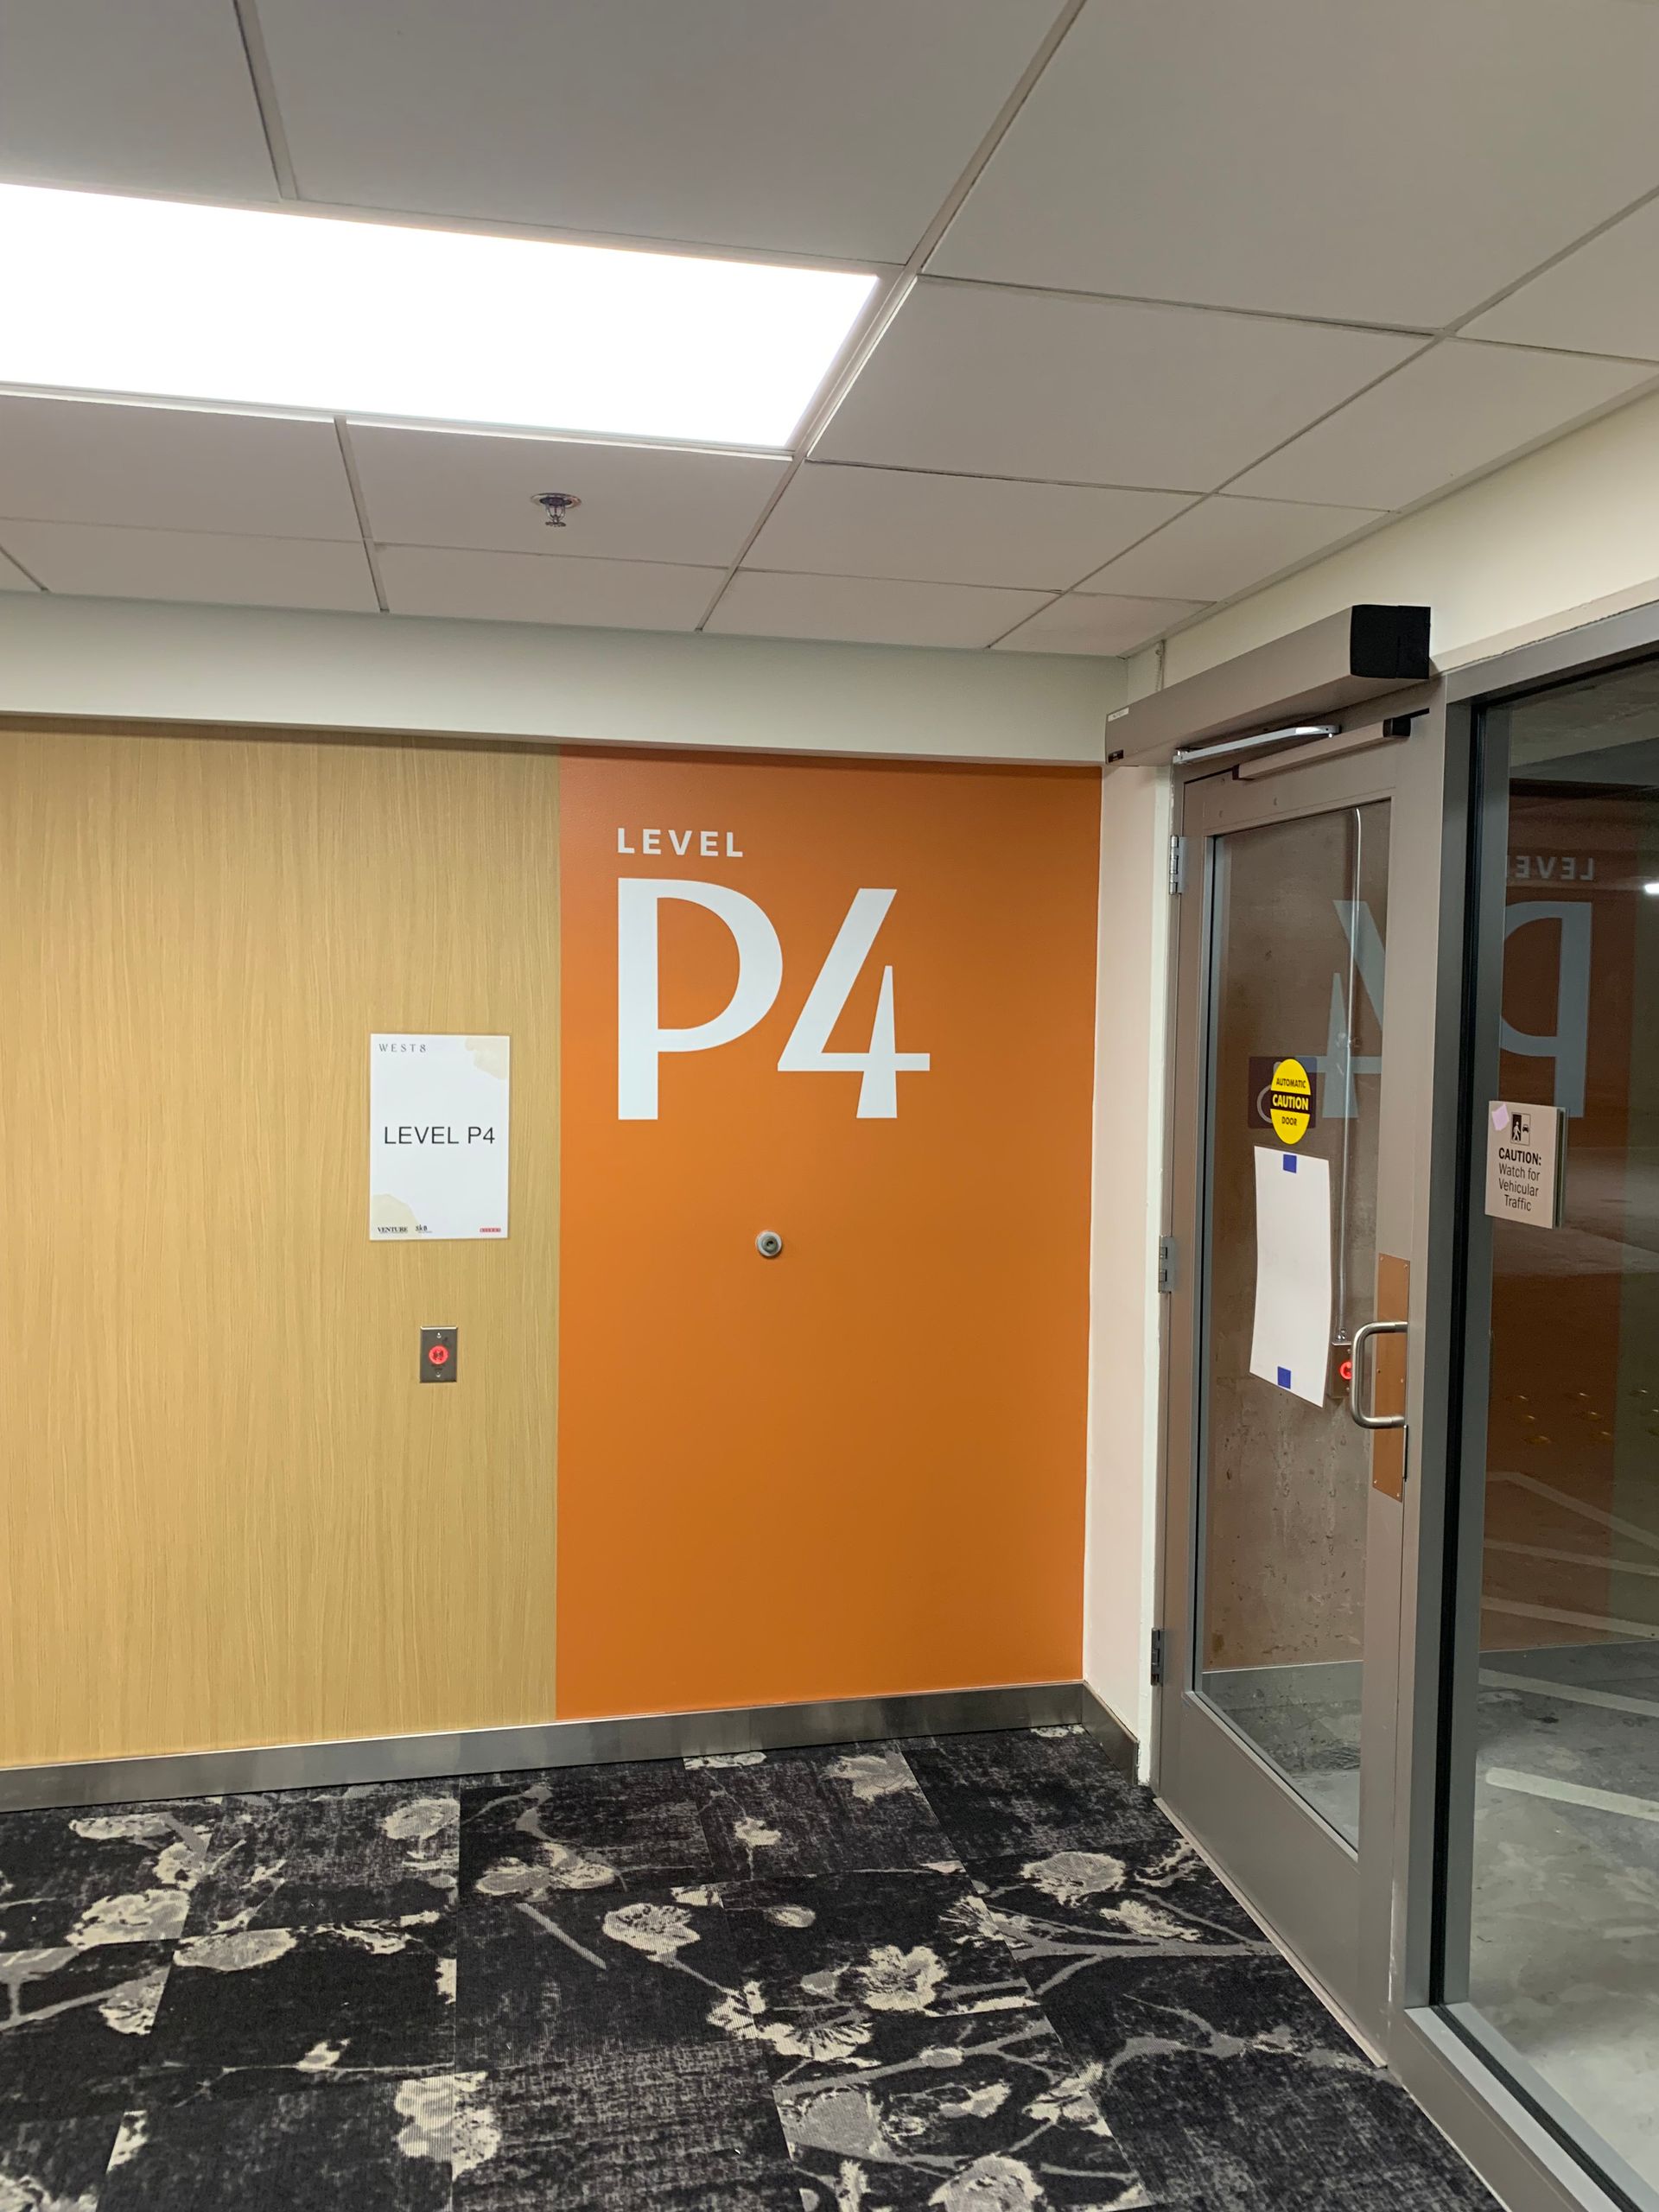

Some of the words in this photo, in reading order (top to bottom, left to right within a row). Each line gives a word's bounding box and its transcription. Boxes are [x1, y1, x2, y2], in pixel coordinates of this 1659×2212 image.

[617, 828, 744, 858] LEVEL
[618, 877, 931, 1121] P4
[1275, 1077, 1306, 1089] AUTOMATIC
[1272, 1094, 1309, 1111] CAUTION
[1281, 1116, 1298, 1126] DOOR
[385, 1126, 460, 1145] LEVEL
[467, 1127, 495, 1145] P4
[1498, 1147, 1542, 1166] CAUTION:
[1498, 1162, 1526, 1179] Watch
[1528, 1167, 1541, 1182] for
[1498, 1178, 1539, 1198] Vehicular
[1504, 1194, 1532, 1211] Traffic
